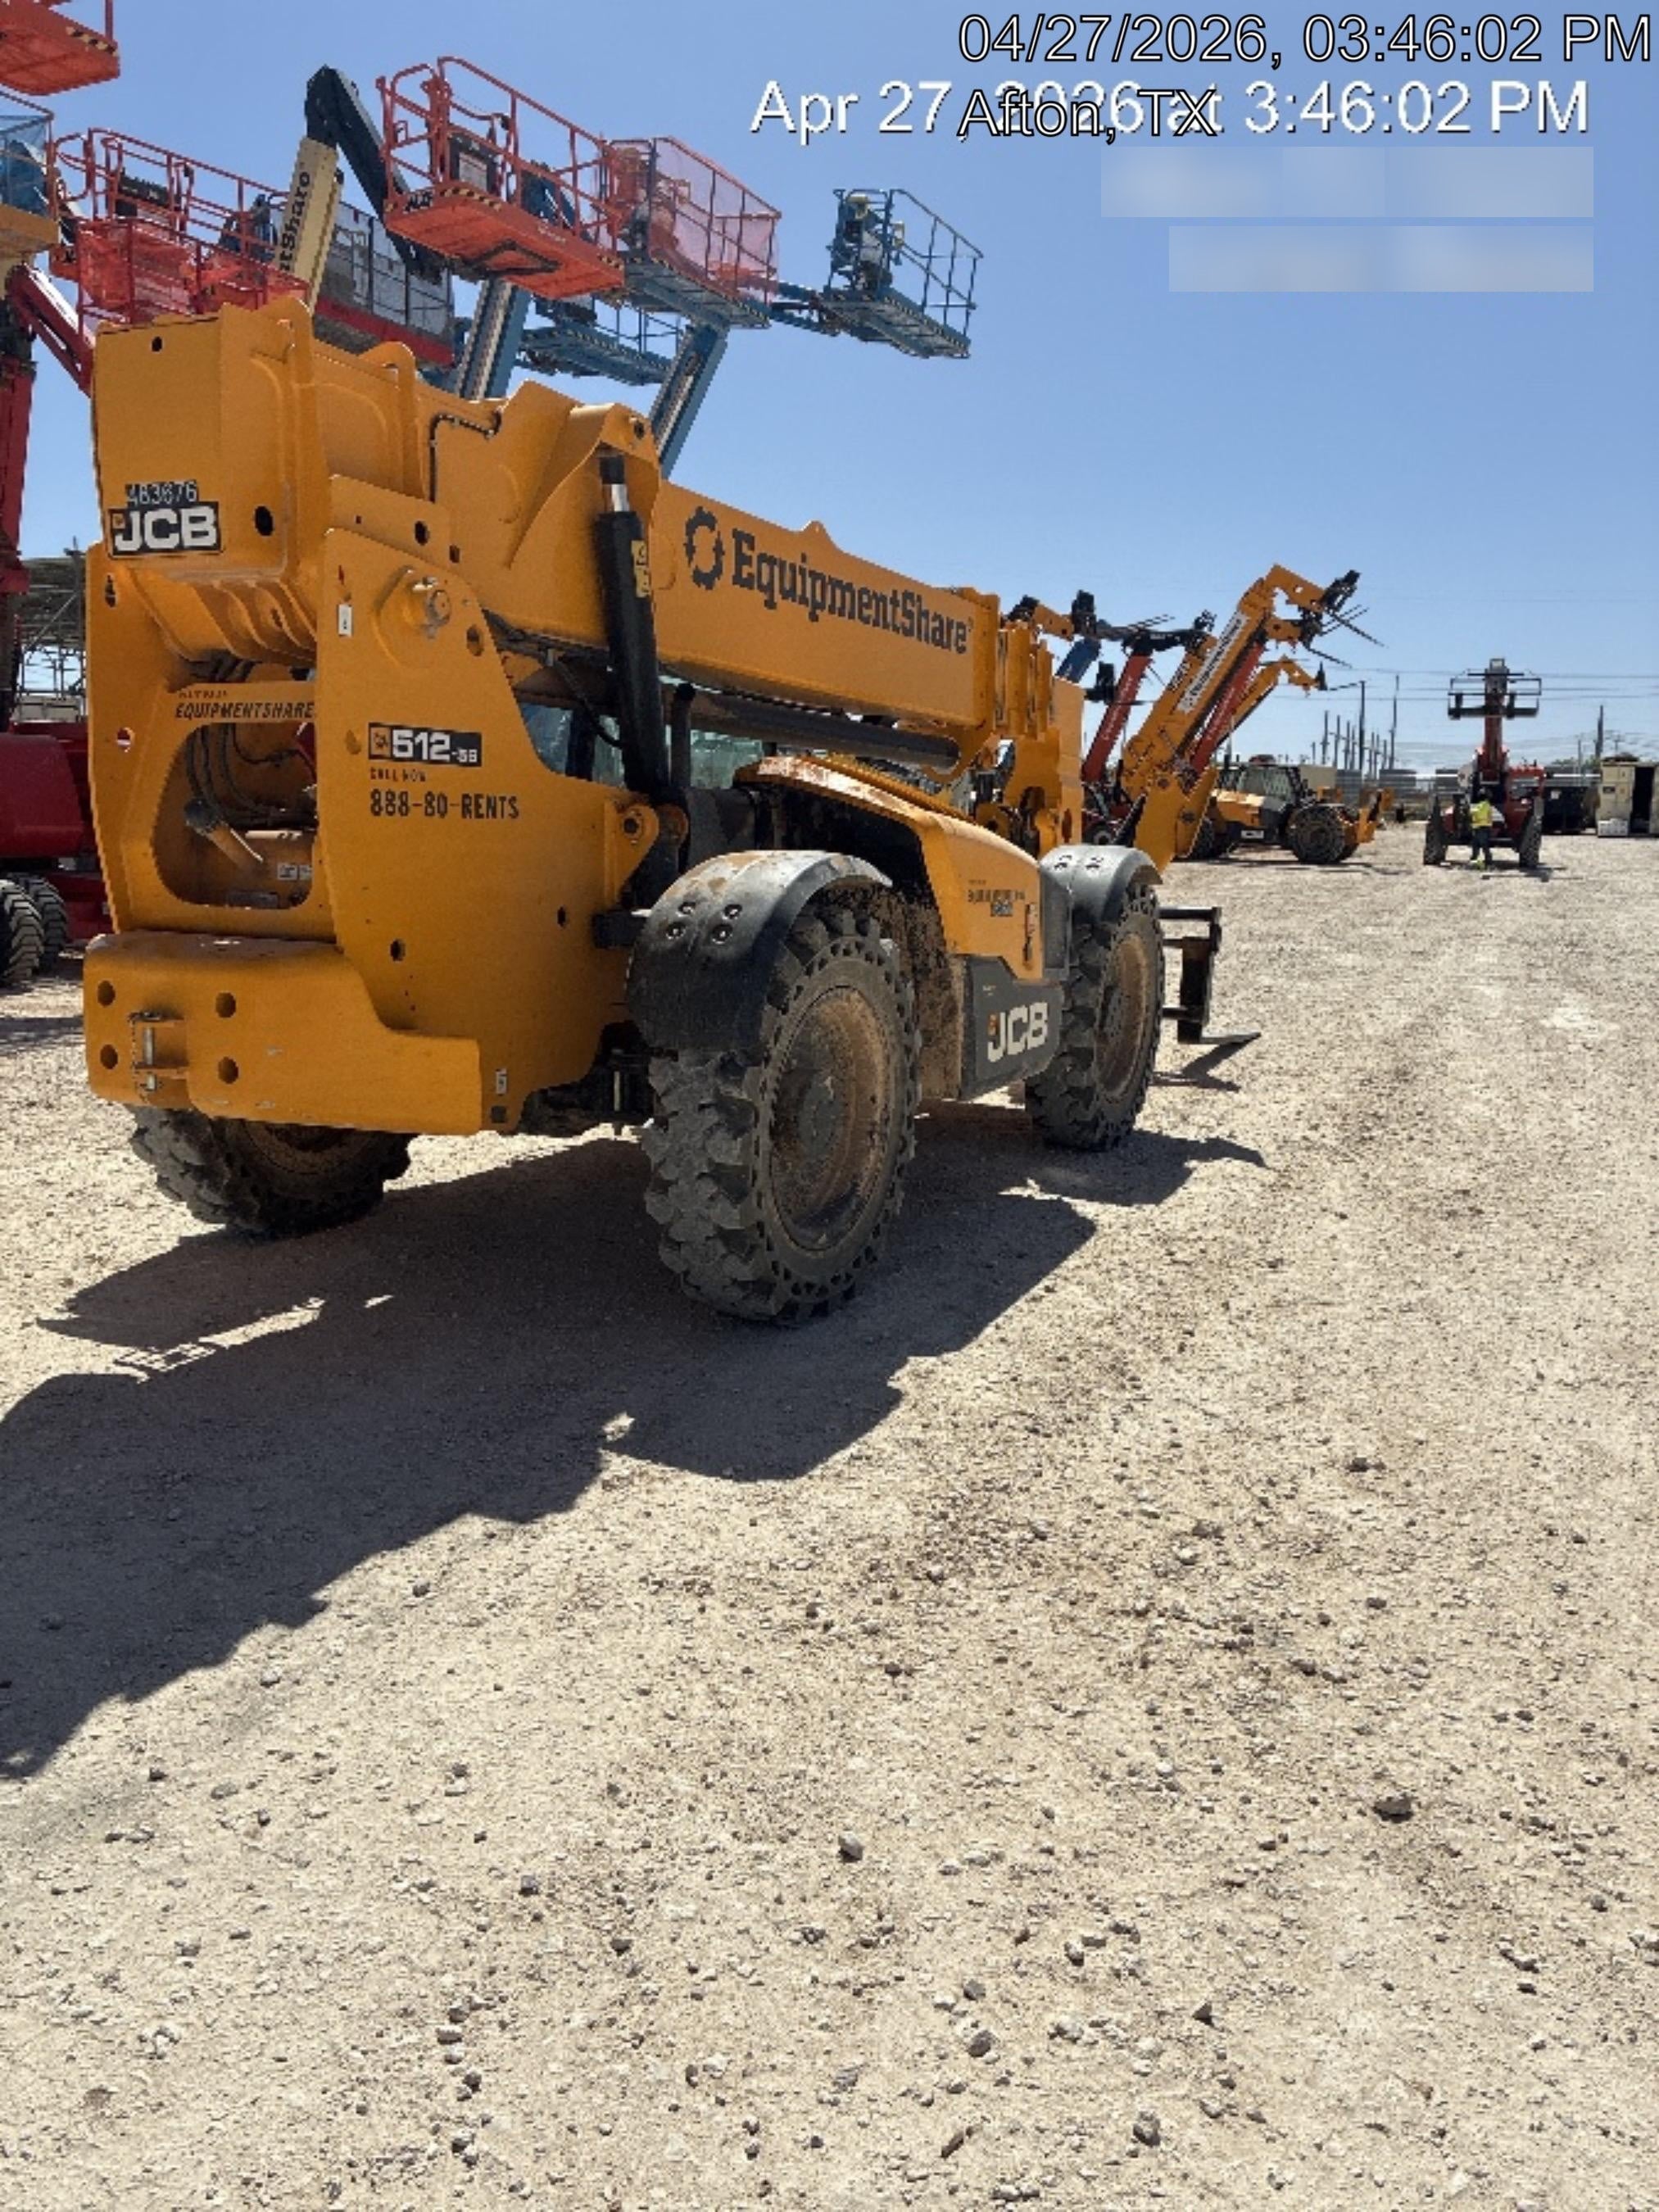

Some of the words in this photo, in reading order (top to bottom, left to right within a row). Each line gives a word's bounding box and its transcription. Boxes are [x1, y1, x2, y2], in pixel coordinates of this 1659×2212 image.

[114, 506, 218, 551] JCB
[732, 528, 968, 655] EquipmentShare
[369, 788, 520, 820] 888-80-RENTS
[986, 1001, 1049, 1063] JCB
